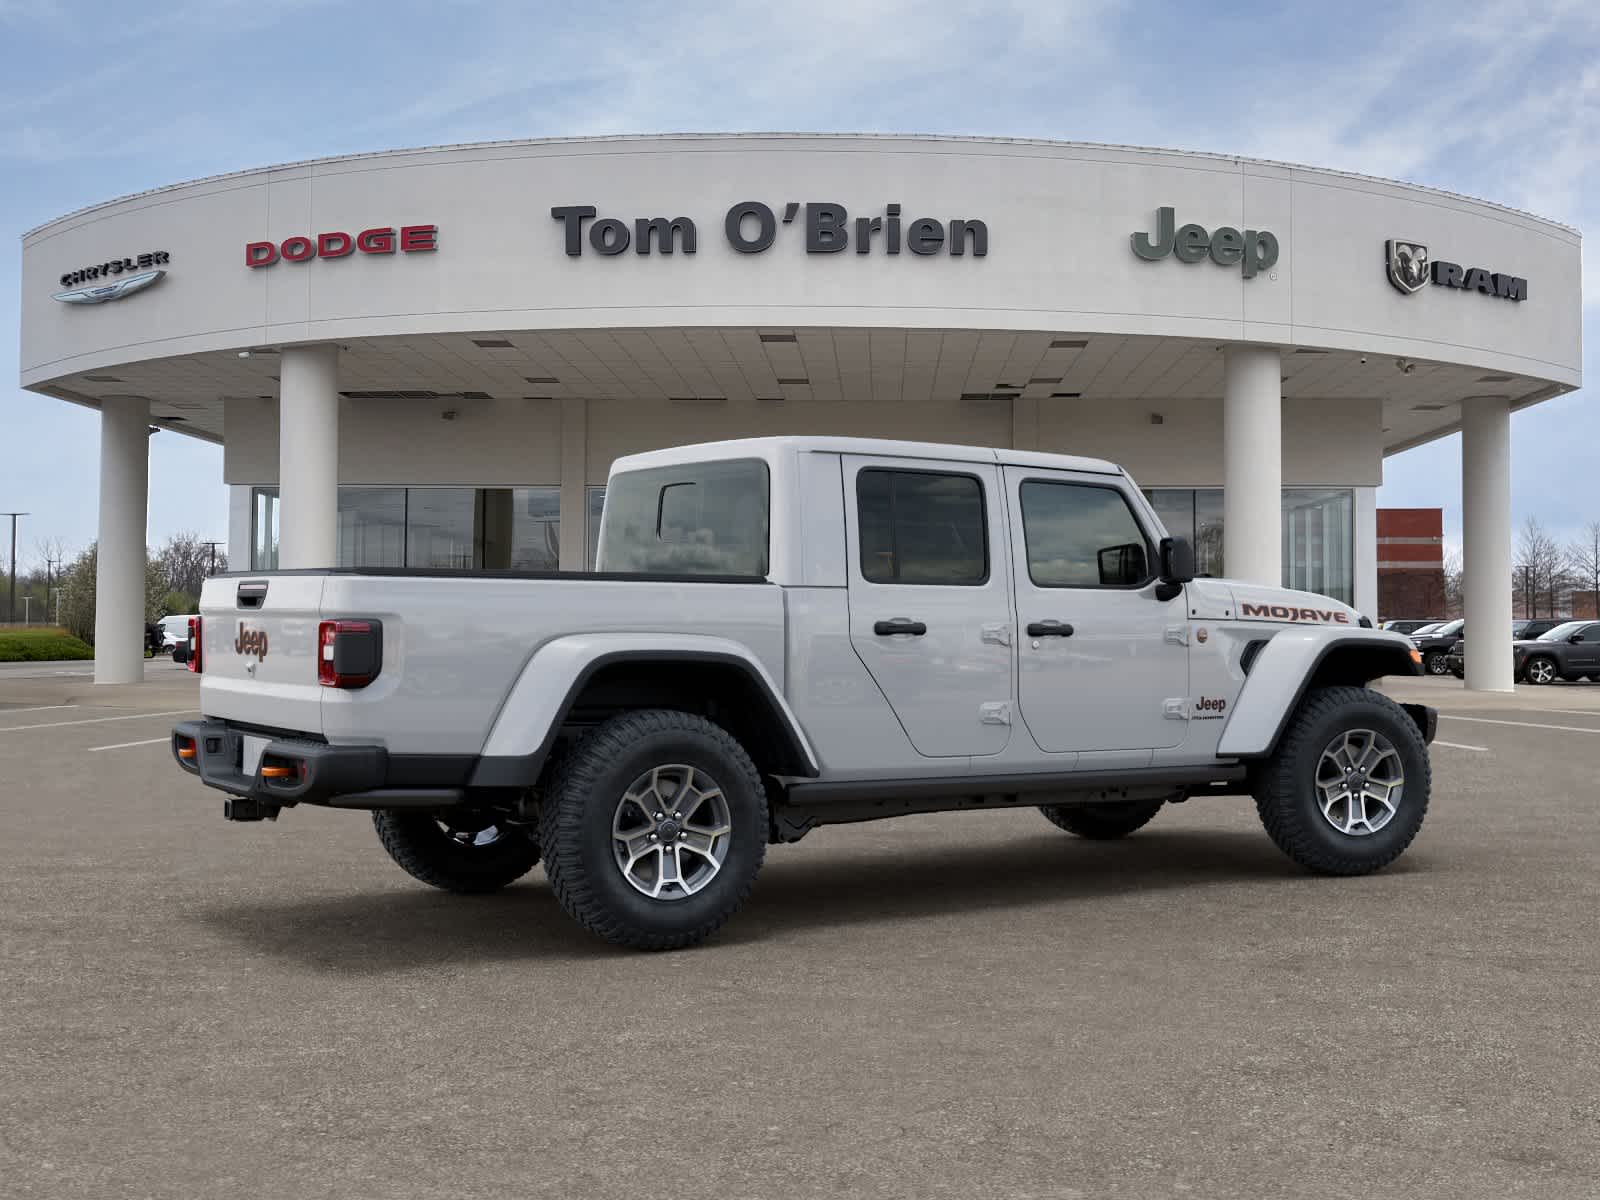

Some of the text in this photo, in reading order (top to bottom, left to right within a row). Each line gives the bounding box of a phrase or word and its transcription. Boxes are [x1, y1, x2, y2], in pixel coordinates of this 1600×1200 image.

[246, 224, 437, 268] DODGE
[551, 201, 988, 256] Tom O'Brien
[1130, 206, 1280, 279] Jeep
[60, 250, 170, 288] CHRYSLER
[1431, 261, 1528, 301] RAM
[1242, 603, 1349, 624] MOJAVE
[235, 621, 268, 663] Jeep
[1196, 696, 1226, 713] Jeep
